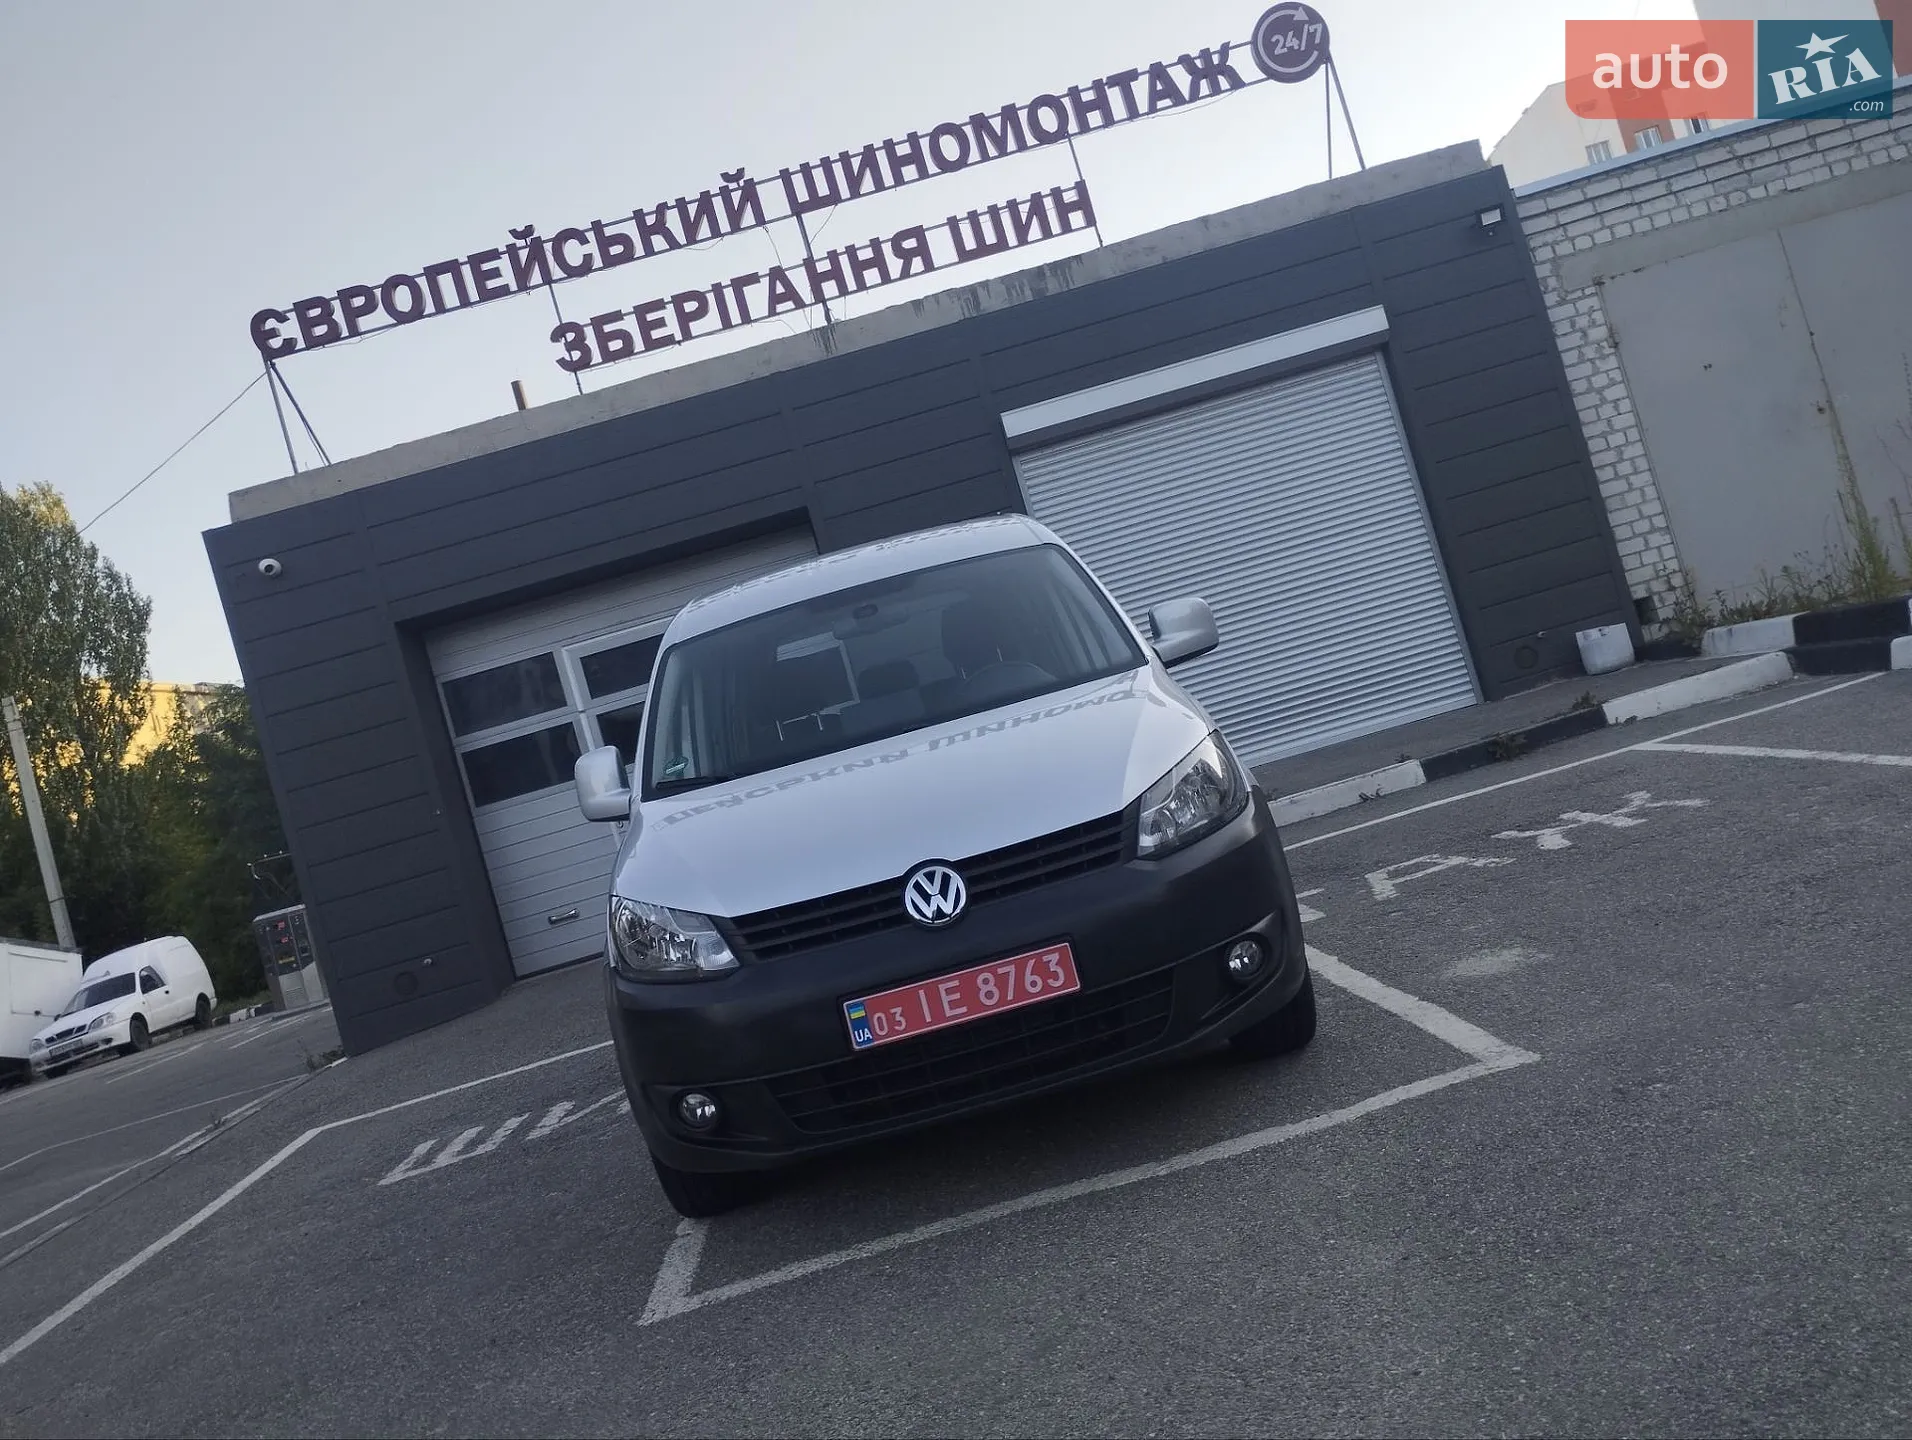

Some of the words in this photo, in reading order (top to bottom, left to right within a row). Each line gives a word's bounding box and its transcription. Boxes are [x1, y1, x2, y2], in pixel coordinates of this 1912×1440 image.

[1270, 23, 1322, 55] 24/7
[250, 168, 767, 357] ЄВРОПЕЙСЬКИЙ
[779, 41, 1245, 213] ШИНОМОНТАЖ
[550, 225, 934, 372] ЗБЕРІГАННЯ
[946, 179, 1096, 261] ШИН
[855, 1029, 872, 1042] UA
[873, 1007, 906, 1036] 03
[918, 980, 968, 1023] IE
[976, 952, 1065, 1006] 8763
